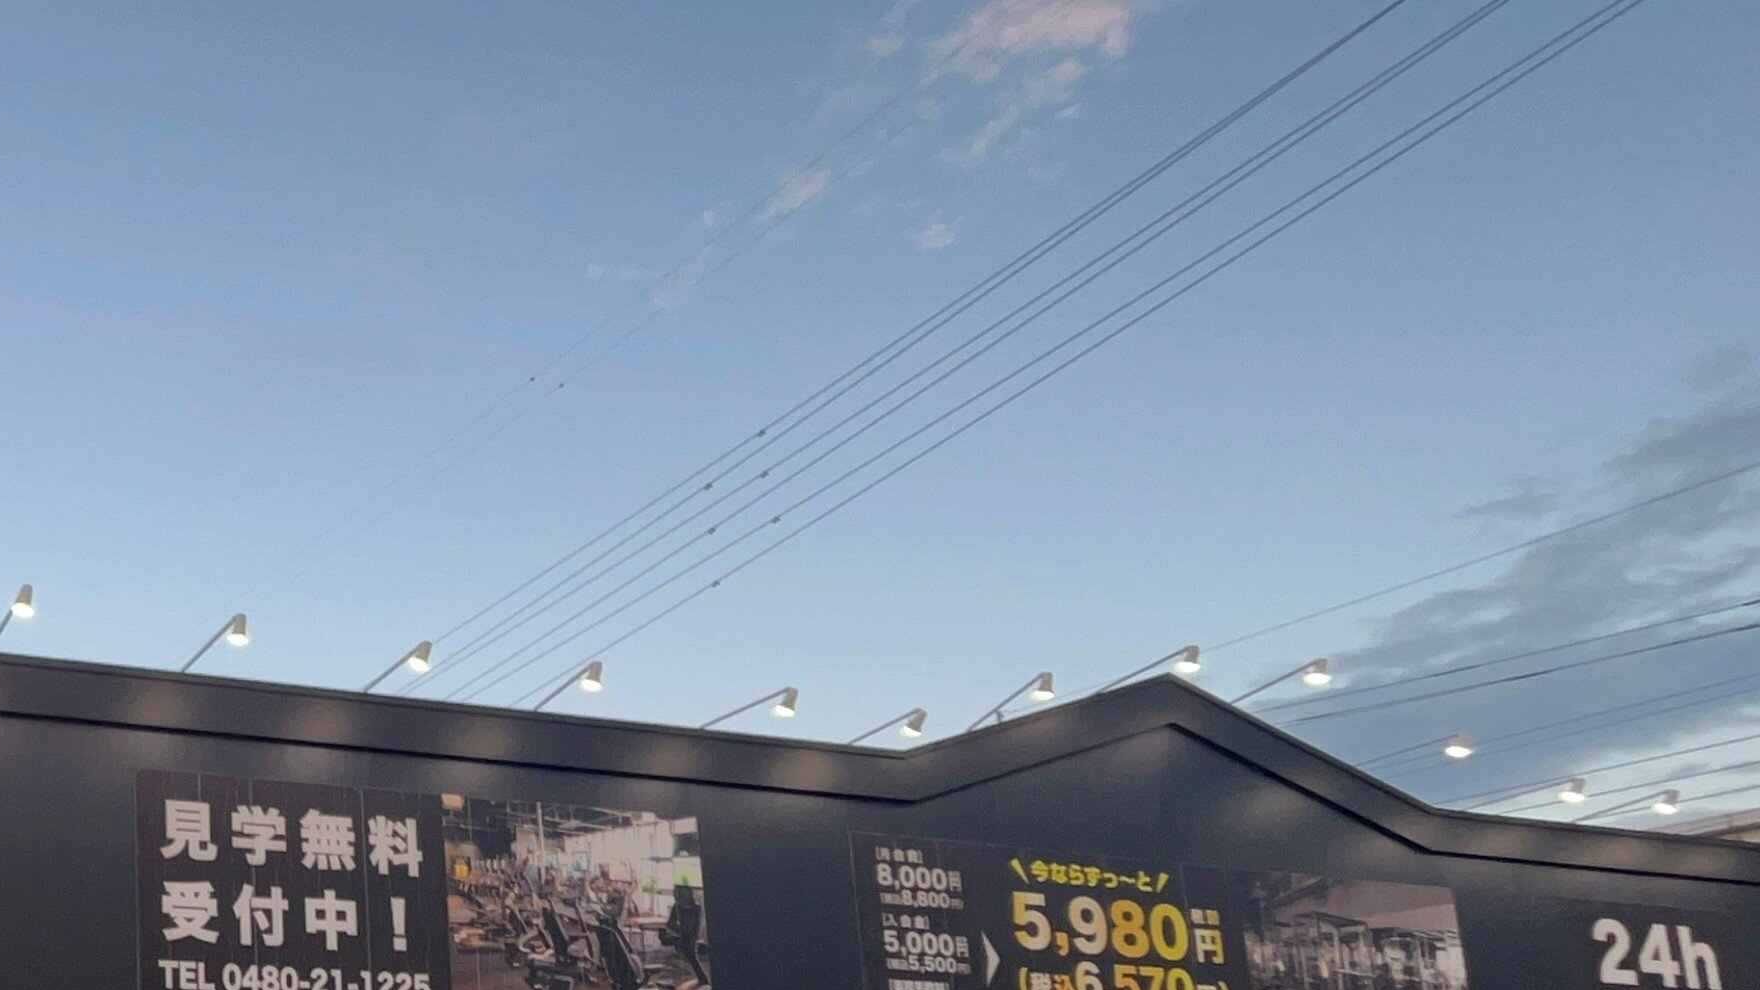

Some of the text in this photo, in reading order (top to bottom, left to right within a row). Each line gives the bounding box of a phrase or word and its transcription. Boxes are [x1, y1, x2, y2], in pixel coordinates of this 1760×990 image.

[159, 799, 424, 878] 見学無料
[1592, 917, 1723, 990] 24h
